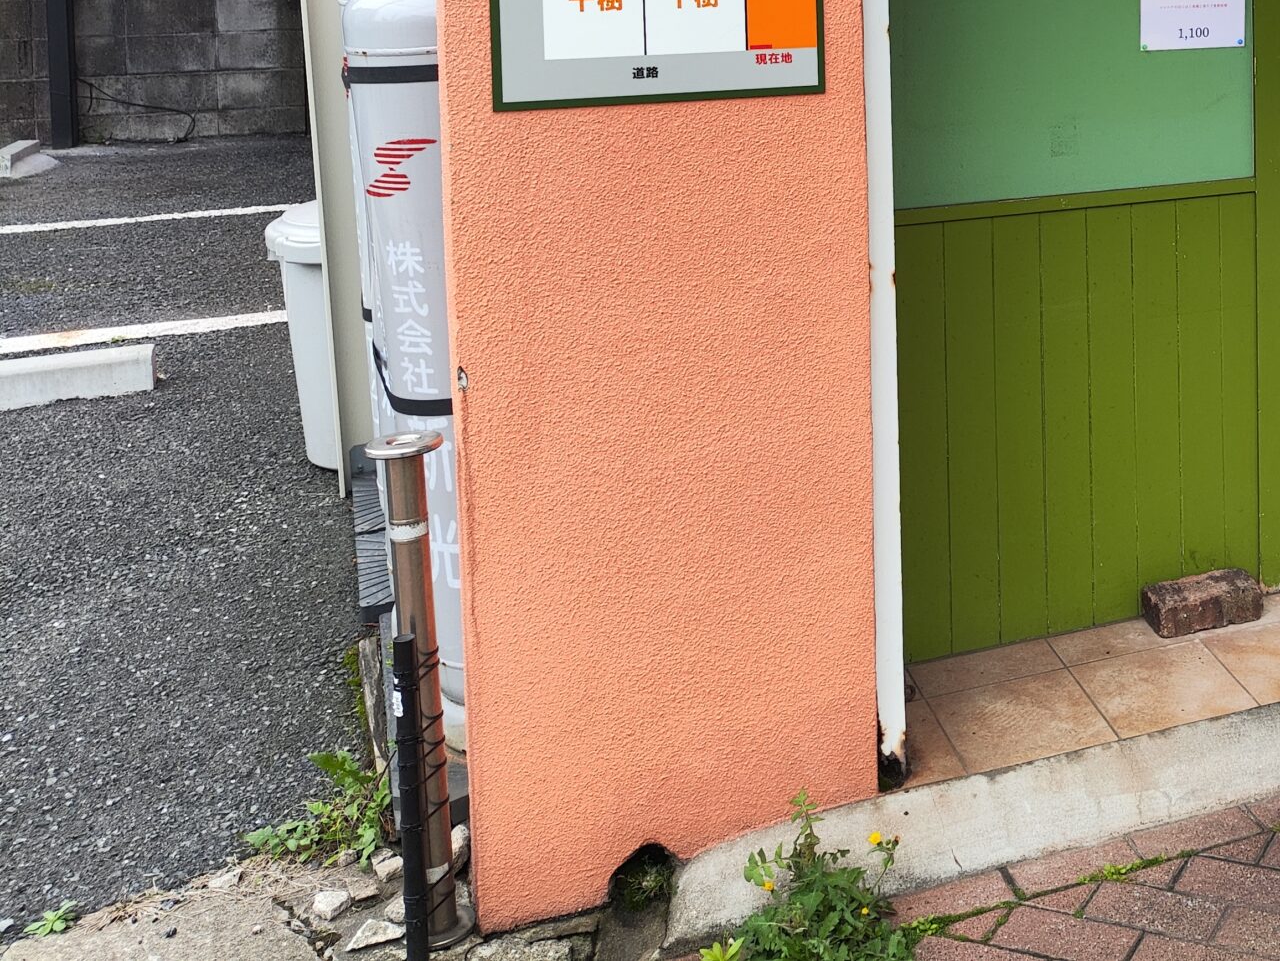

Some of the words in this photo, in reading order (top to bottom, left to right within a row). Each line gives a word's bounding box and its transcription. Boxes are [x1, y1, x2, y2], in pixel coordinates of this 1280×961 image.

[1178, 27, 1210, 40] 1,100
[755, 52, 793, 65] 現在地
[632, 66, 659, 79] 道路
[386, 240, 439, 395] 株式会社
